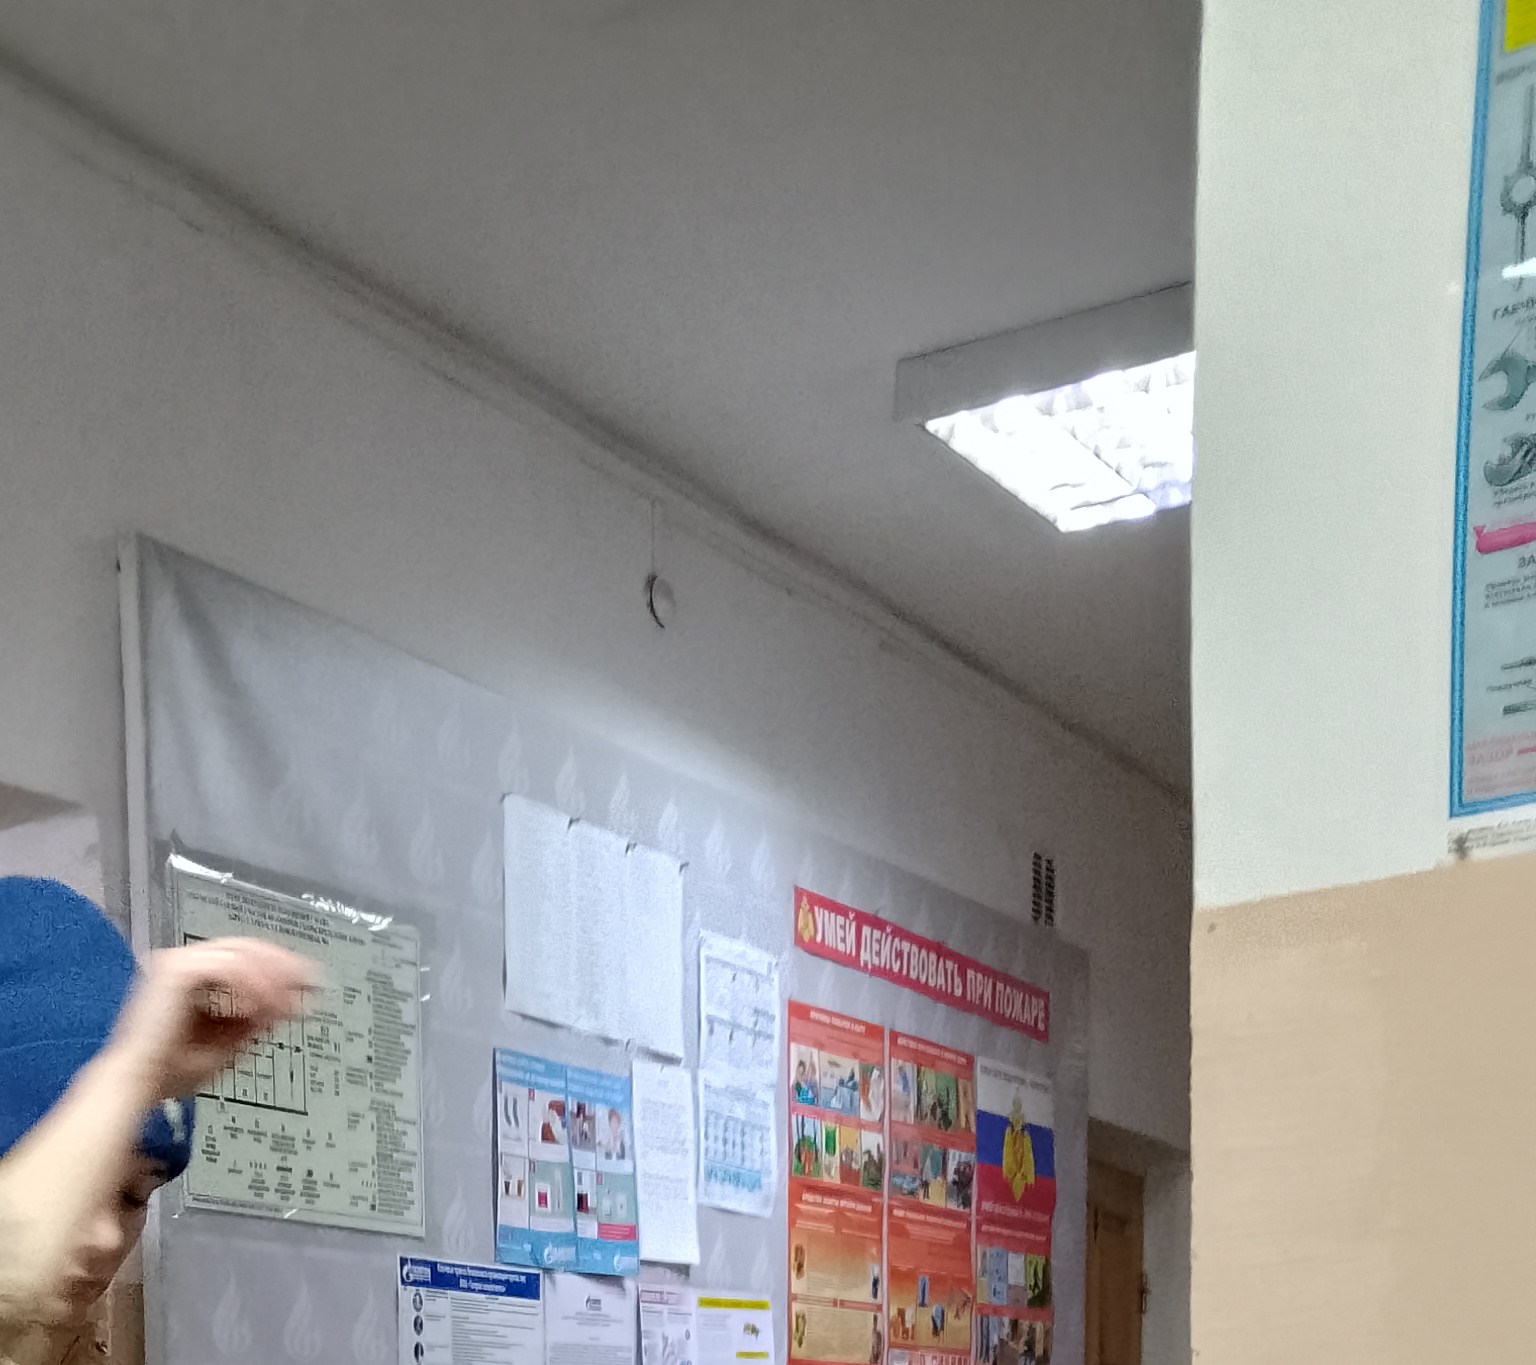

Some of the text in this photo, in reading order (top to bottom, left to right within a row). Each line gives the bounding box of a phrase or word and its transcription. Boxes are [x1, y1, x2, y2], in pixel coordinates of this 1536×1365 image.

[814, 905, 1047, 1032] УМЕЙ ДЕЙСТВОВАТЬ ПРИ ПОЖАРЕ
